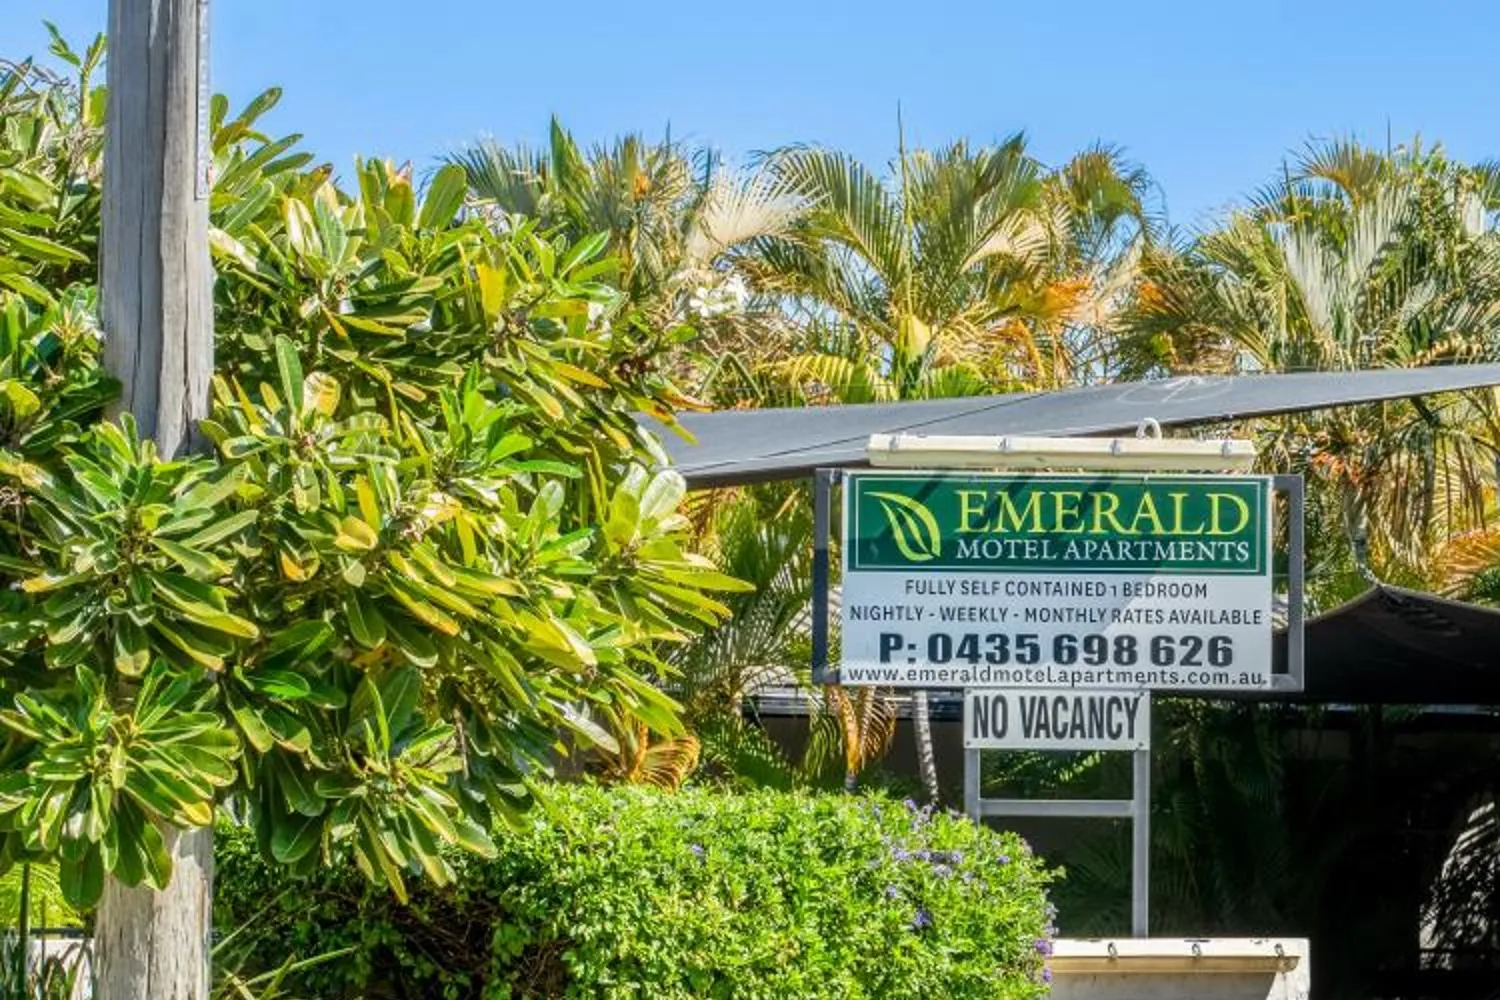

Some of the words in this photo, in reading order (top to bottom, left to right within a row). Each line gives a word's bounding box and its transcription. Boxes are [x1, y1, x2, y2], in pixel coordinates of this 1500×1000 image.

[954, 490, 1250, 535] EMERALD
[956, 539, 1057, 560] MOTEL
[1063, 540, 1250, 562] APARTMENTS
[905, 580, 955, 595] FULLY
[960, 580, 1000, 596] SELF
[1005, 581, 1107, 597] CONTAINED
[1110, 585, 1118, 598] 1
[1123, 582, 1208, 599] BEDROOM
[850, 605, 924, 621] NIGHTLY
[939, 606, 1009, 622] WEEKLY
[1025, 607, 1106, 624] MONTHLY
[1111, 608, 1164, 624] RATES
[1169, 609, 1262, 625] AVAILABLE
[879, 632, 918, 664] P:
[927, 632, 1041, 665] 0435
[1053, 633, 1139, 666] 698
[1151, 635, 1234, 667] 626
[972, 695, 1009, 740] NO
[1019, 695, 1140, 740] VACANCY
